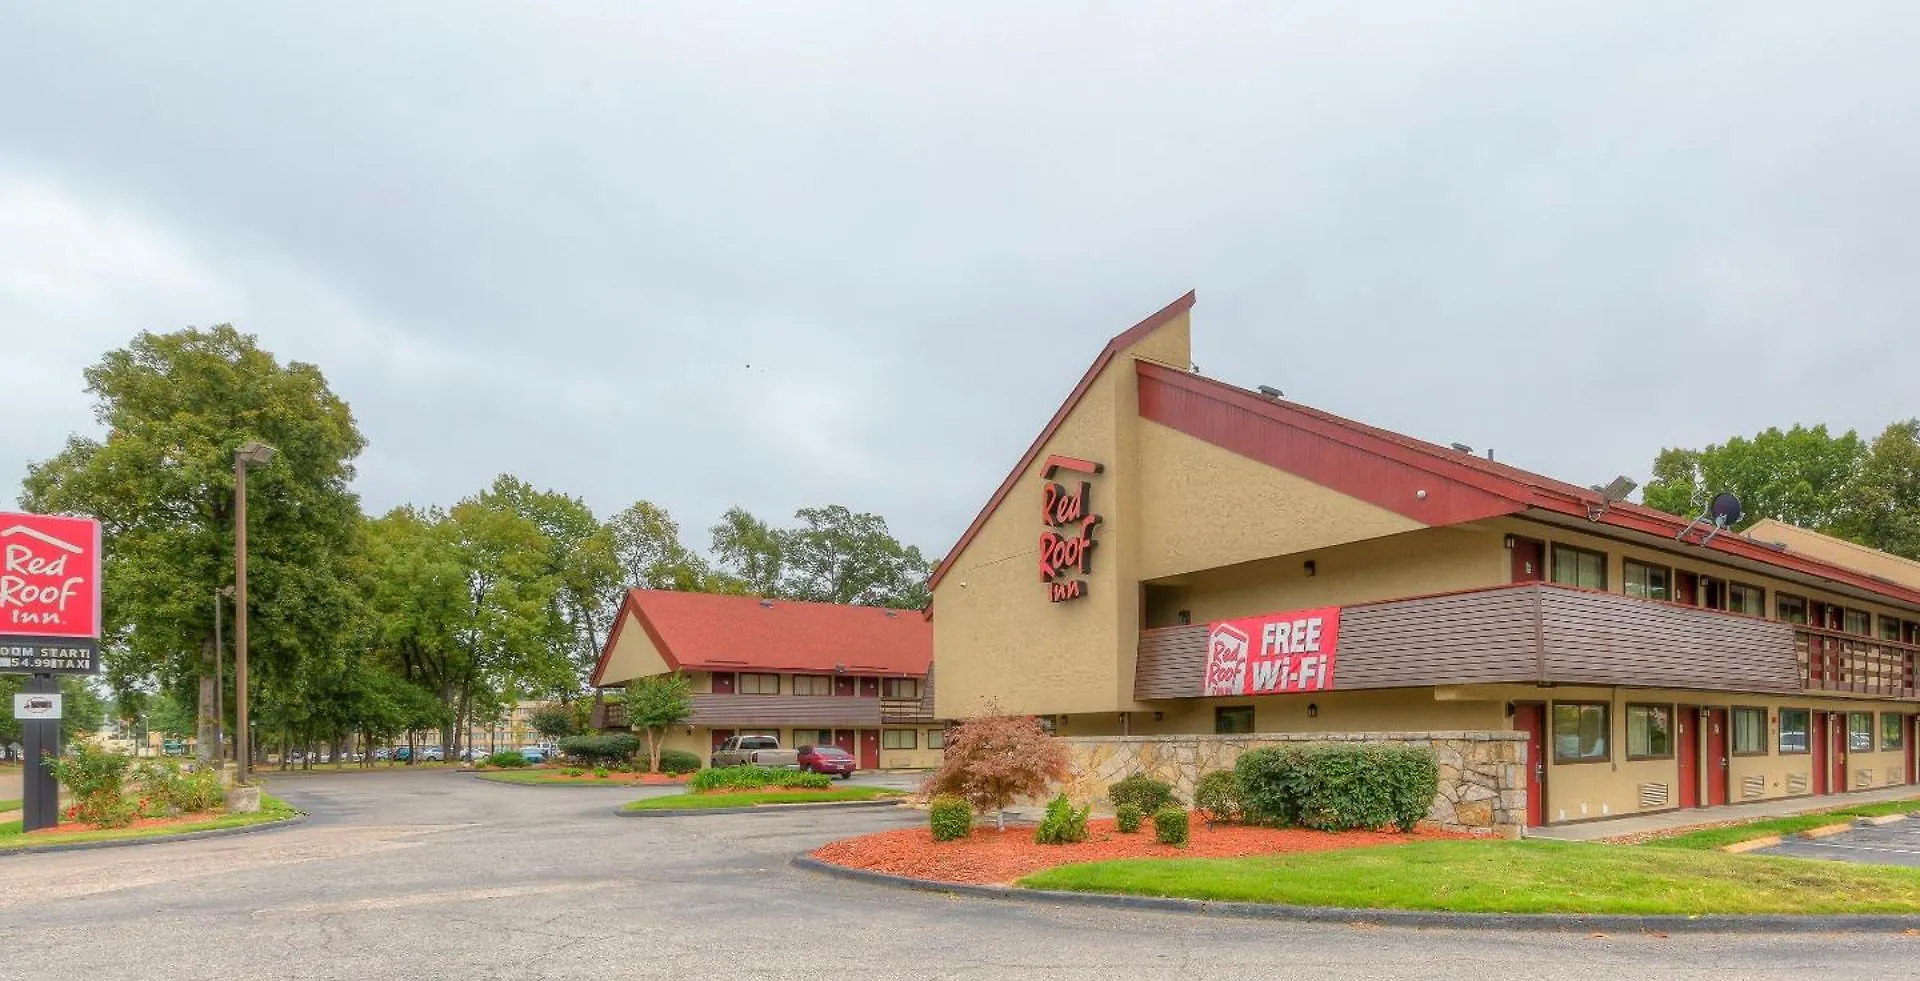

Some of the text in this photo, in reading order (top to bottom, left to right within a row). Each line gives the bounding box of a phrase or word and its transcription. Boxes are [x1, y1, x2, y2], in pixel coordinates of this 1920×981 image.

[1043, 481, 1088, 526] Red
[6, 544, 68, 576] Red
[1040, 514, 1098, 580] Roof
[0, 575, 84, 610] Roof
[1213, 640, 1241, 664] Red
[1261, 617, 1322, 656] FREE
[1209, 657, 1246, 685] Roof
[1252, 654, 1328, 692] Wi-Fi
